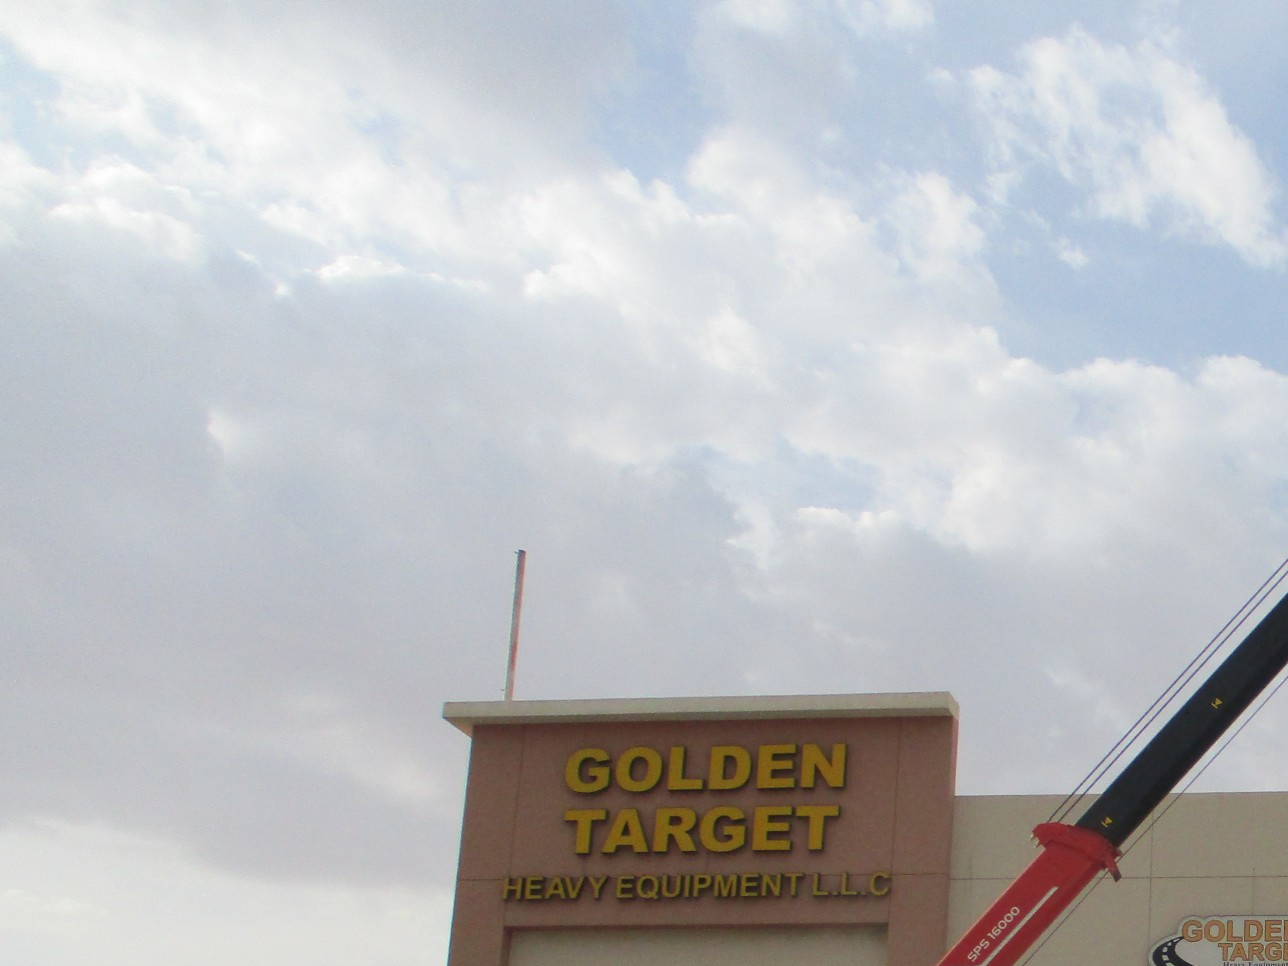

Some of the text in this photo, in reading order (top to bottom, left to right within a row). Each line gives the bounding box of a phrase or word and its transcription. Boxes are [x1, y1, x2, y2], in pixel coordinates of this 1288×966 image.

[564, 743, 847, 793] GOLDEN
[564, 805, 839, 854] TARGET
[503, 871, 891, 899] HEAVY EQUIPMENT L.L.C
[967, 906, 1020, 963] SPS 16000
